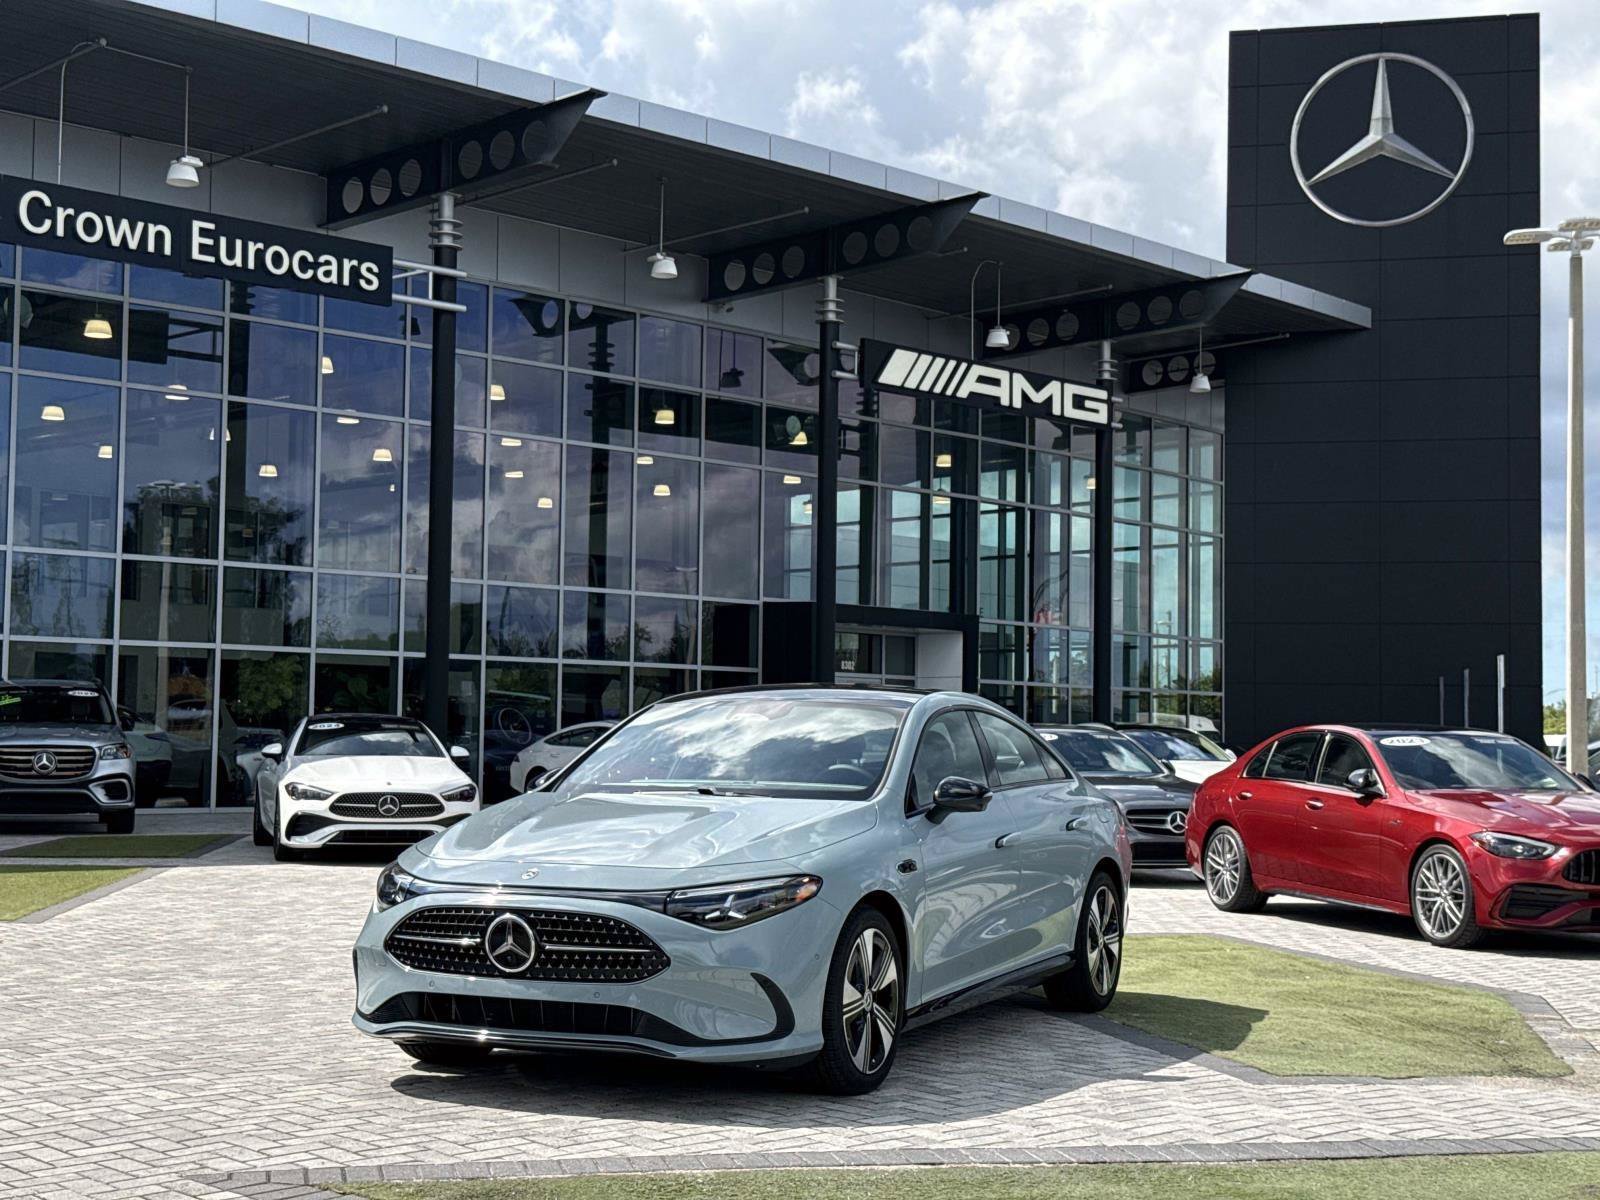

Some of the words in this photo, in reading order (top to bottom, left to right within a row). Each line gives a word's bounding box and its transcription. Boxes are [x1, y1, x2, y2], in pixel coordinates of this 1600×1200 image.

[18, 190, 172, 256] Crown
[191, 219, 381, 292] Eurocars
[956, 363, 1109, 425] AMG
